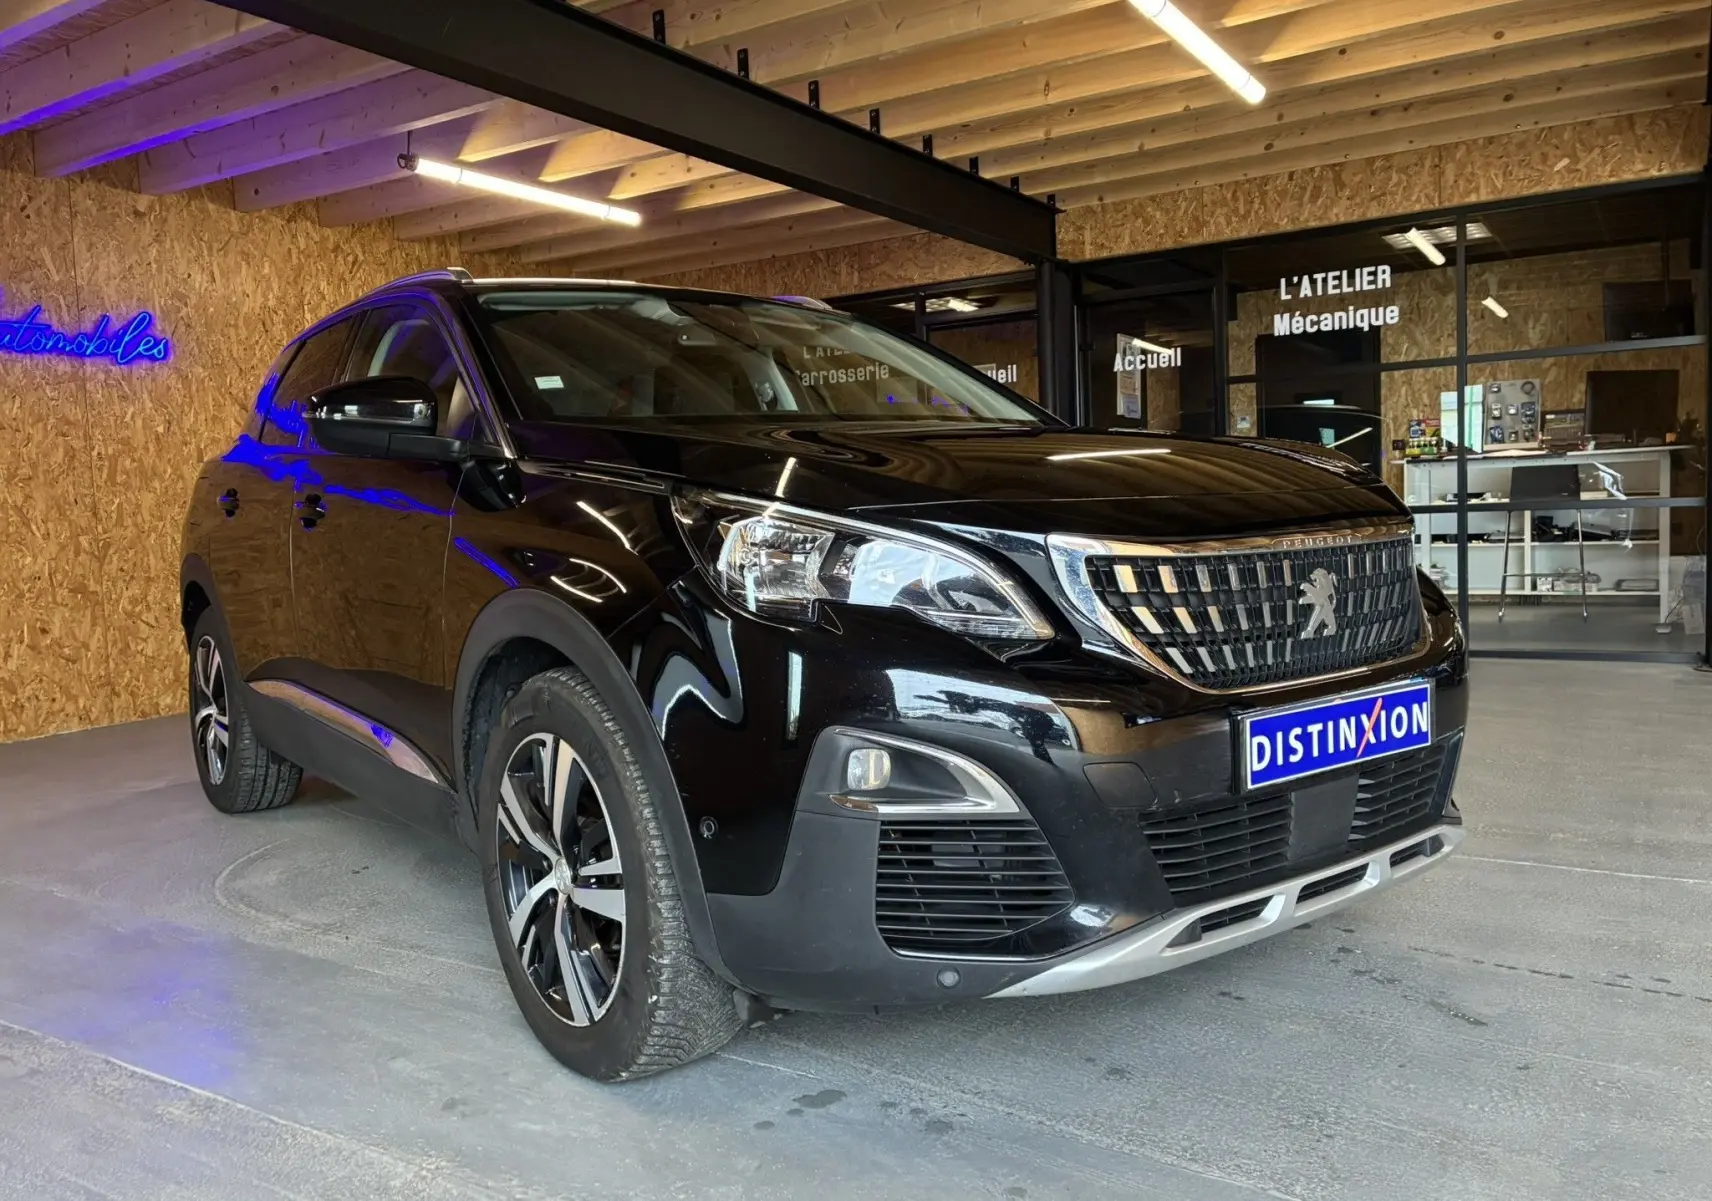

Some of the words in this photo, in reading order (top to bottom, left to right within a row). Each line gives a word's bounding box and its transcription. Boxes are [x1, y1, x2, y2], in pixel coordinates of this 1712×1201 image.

[1280, 265, 1392, 301] L'ATELIER
[0, 305, 168, 364] utomobiles
[1273, 305, 1400, 337] Mécanique
[794, 362, 889, 387] arrosserie
[987, 364, 1017, 384] ueil
[1113, 347, 1183, 373] Accueil
[1282, 534, 1353, 549] PEUGEOT
[1251, 697, 1429, 772] DISTINXION
